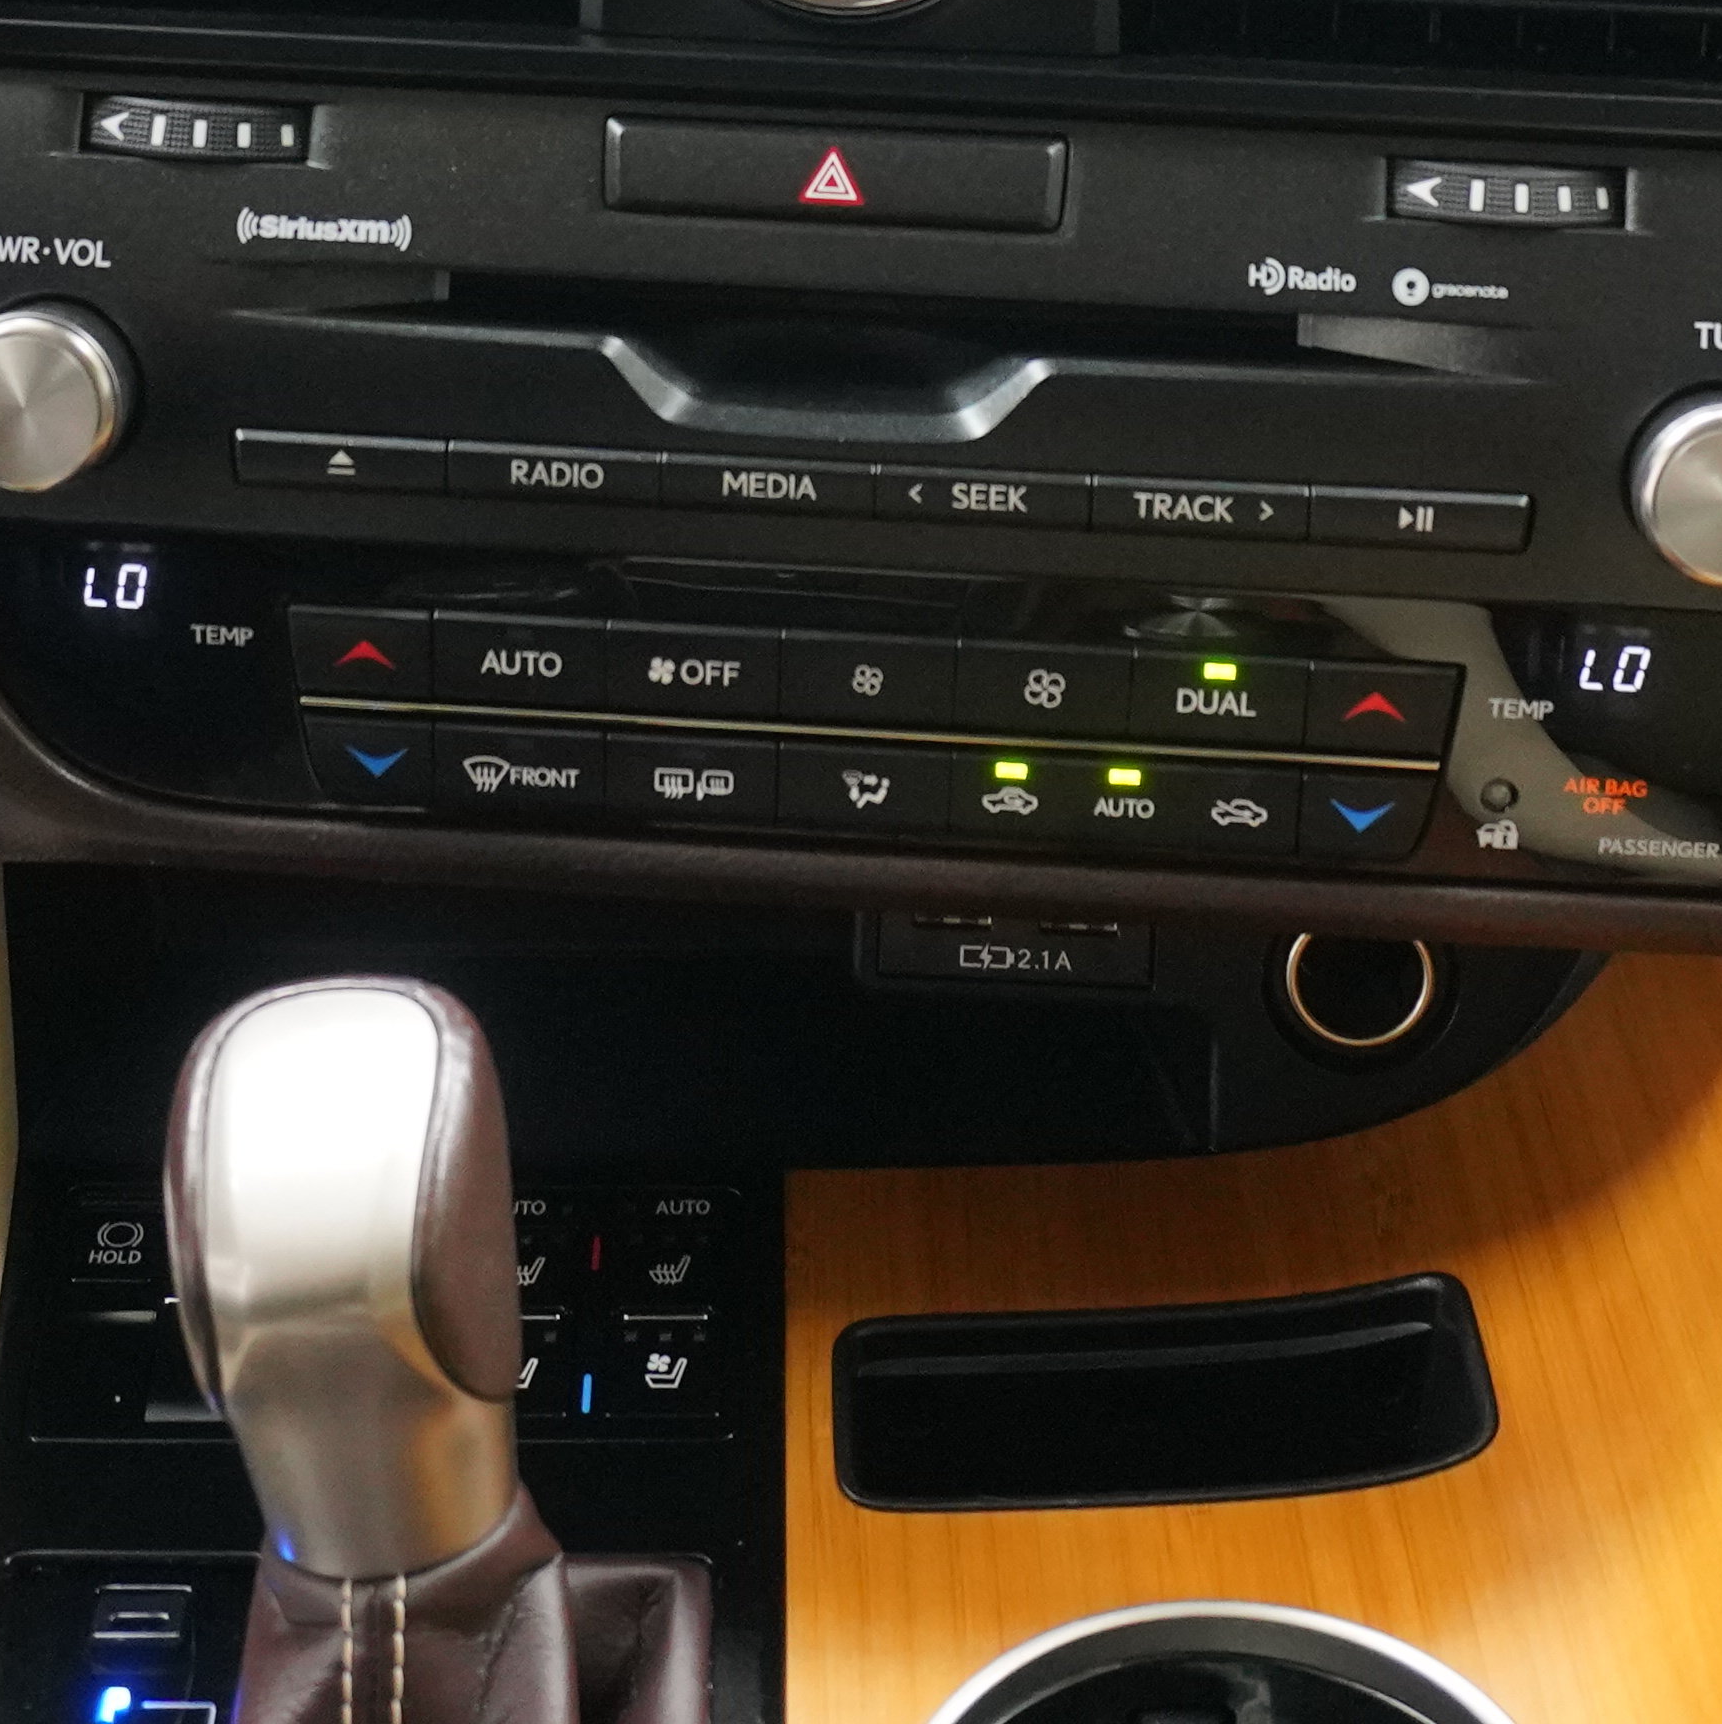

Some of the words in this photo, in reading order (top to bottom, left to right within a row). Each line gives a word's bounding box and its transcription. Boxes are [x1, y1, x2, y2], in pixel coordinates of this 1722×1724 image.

[1287, 264, 1358, 293] Radio
[509, 457, 606, 491] RADIO
[720, 469, 818, 502] MEDIA
[950, 482, 1028, 515] SEEK
[1133, 491, 1235, 525] TRACK
[190, 623, 255, 648] TEMP
[480, 649, 564, 680] AUTO
[679, 658, 742, 688] OFF
[1175, 687, 1258, 719] DUAL
[1488, 697, 1554, 721] TEMP
[509, 764, 581, 790] FRONT
[1562, 777, 1601, 796] AIR
[1604, 779, 1649, 799] BAG
[1092, 796, 1157, 821] AUTO
[1581, 796, 1627, 815] OFF
[1597, 835, 1722, 859] PASSENGER
[1017, 948, 1074, 973] 2.1A
[655, 1198, 712, 1217] AUTO
[88, 1249, 143, 1265] HOLD
